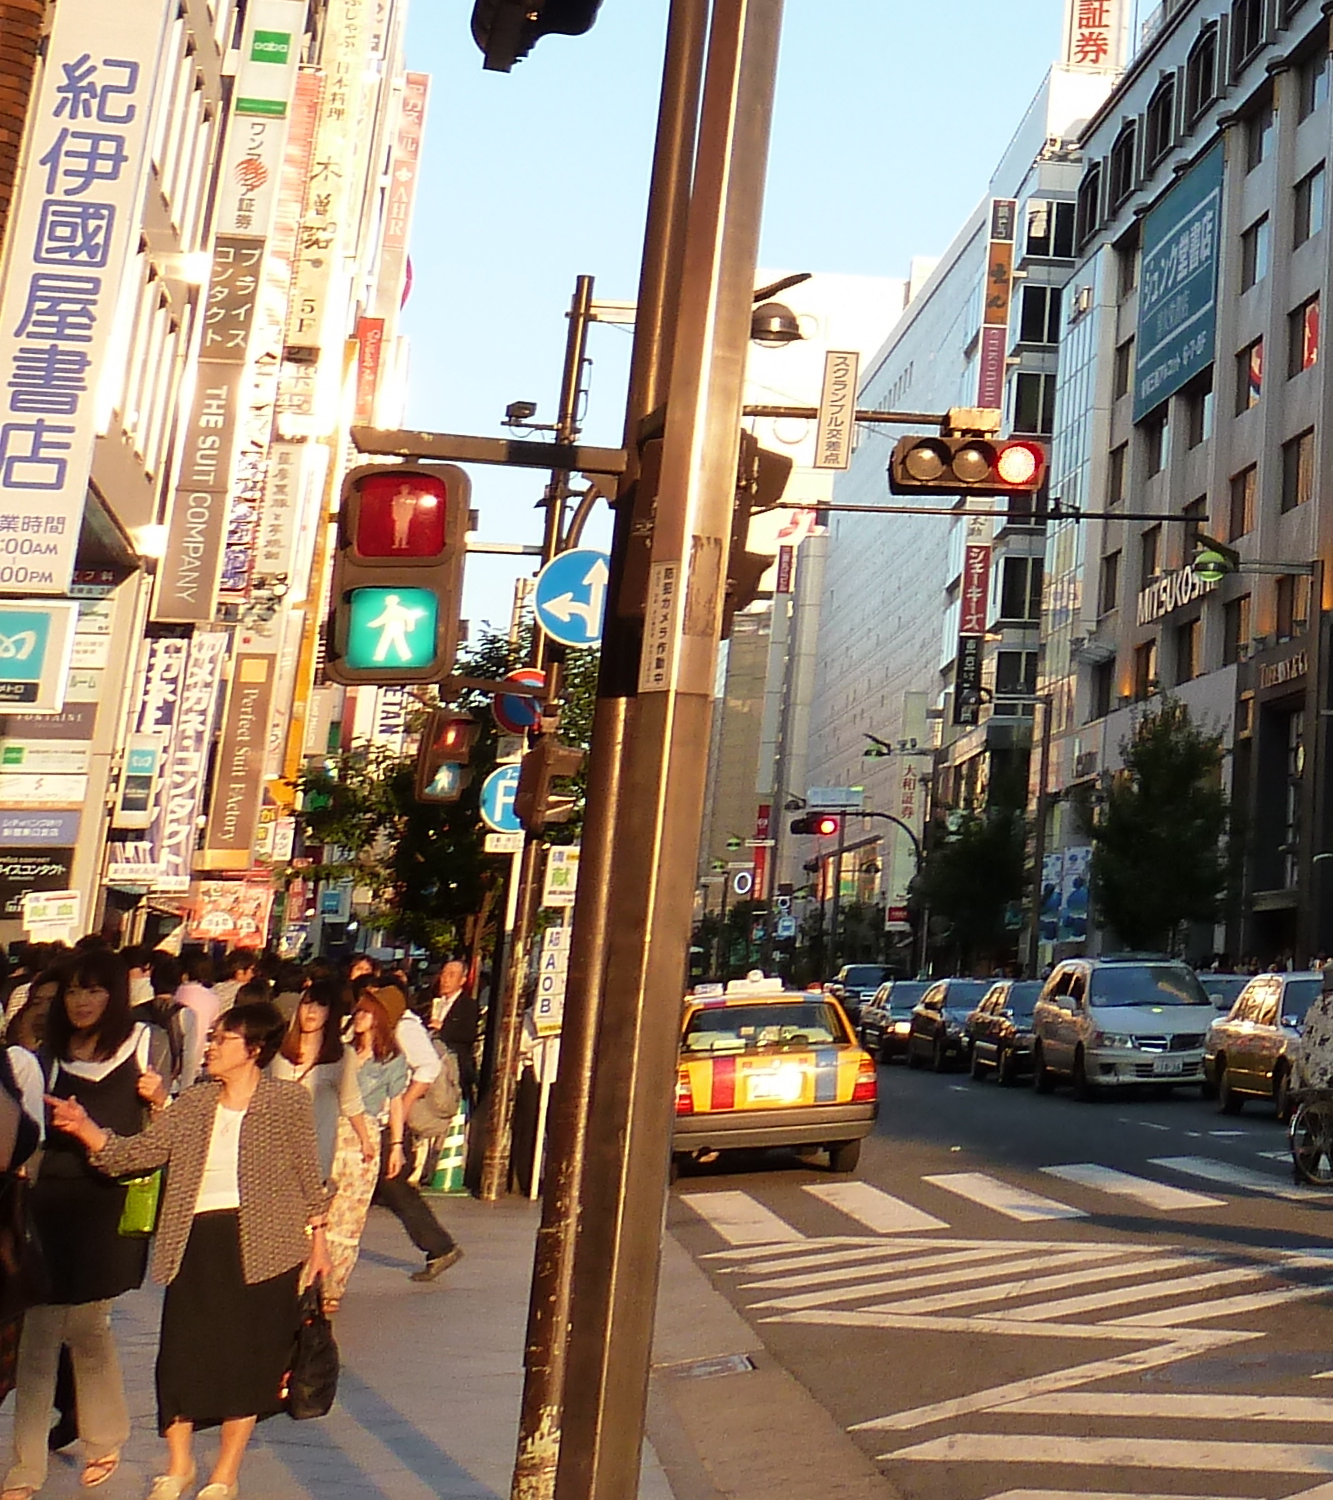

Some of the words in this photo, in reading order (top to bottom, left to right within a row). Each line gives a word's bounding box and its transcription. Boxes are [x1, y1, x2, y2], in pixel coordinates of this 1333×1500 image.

[2, 53, 141, 492] 紀伊國屋書店
[1143, 210, 1215, 312] ジュンク堂書店
[206, 247, 236, 348] コンタクト
[227, 247, 262, 349] プライス
[198, 384, 228, 431] THE
[822, 356, 851, 465] スクランブル交差点
[190, 436, 222, 492] SUIT
[172, 493, 212, 604] COMPANY
[235, 688, 260, 742] Perfect
[230, 744, 249, 778] Suit
[901, 764, 918, 820] 大和証券
[545, 952, 556, 971] A
[539, 997, 551, 1014] B
